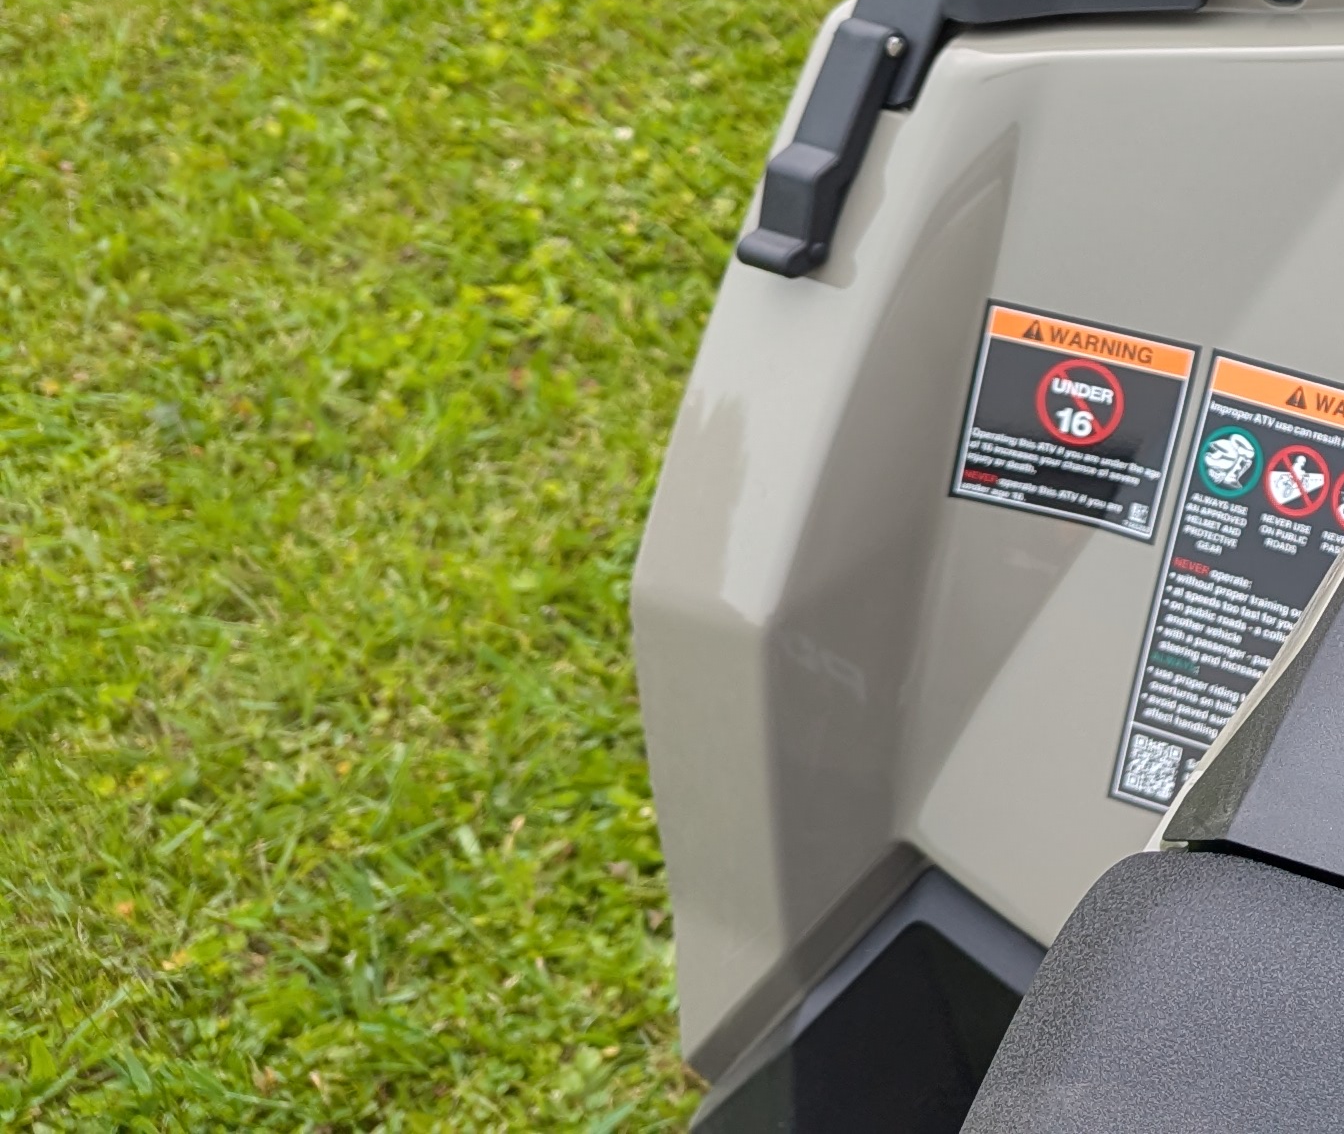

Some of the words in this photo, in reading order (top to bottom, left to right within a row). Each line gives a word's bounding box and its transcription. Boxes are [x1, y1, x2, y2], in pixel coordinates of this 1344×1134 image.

[1050, 325, 1153, 364] WARNING
[1052, 377, 1114, 404] UNDER
[1056, 407, 1094, 437] 16
